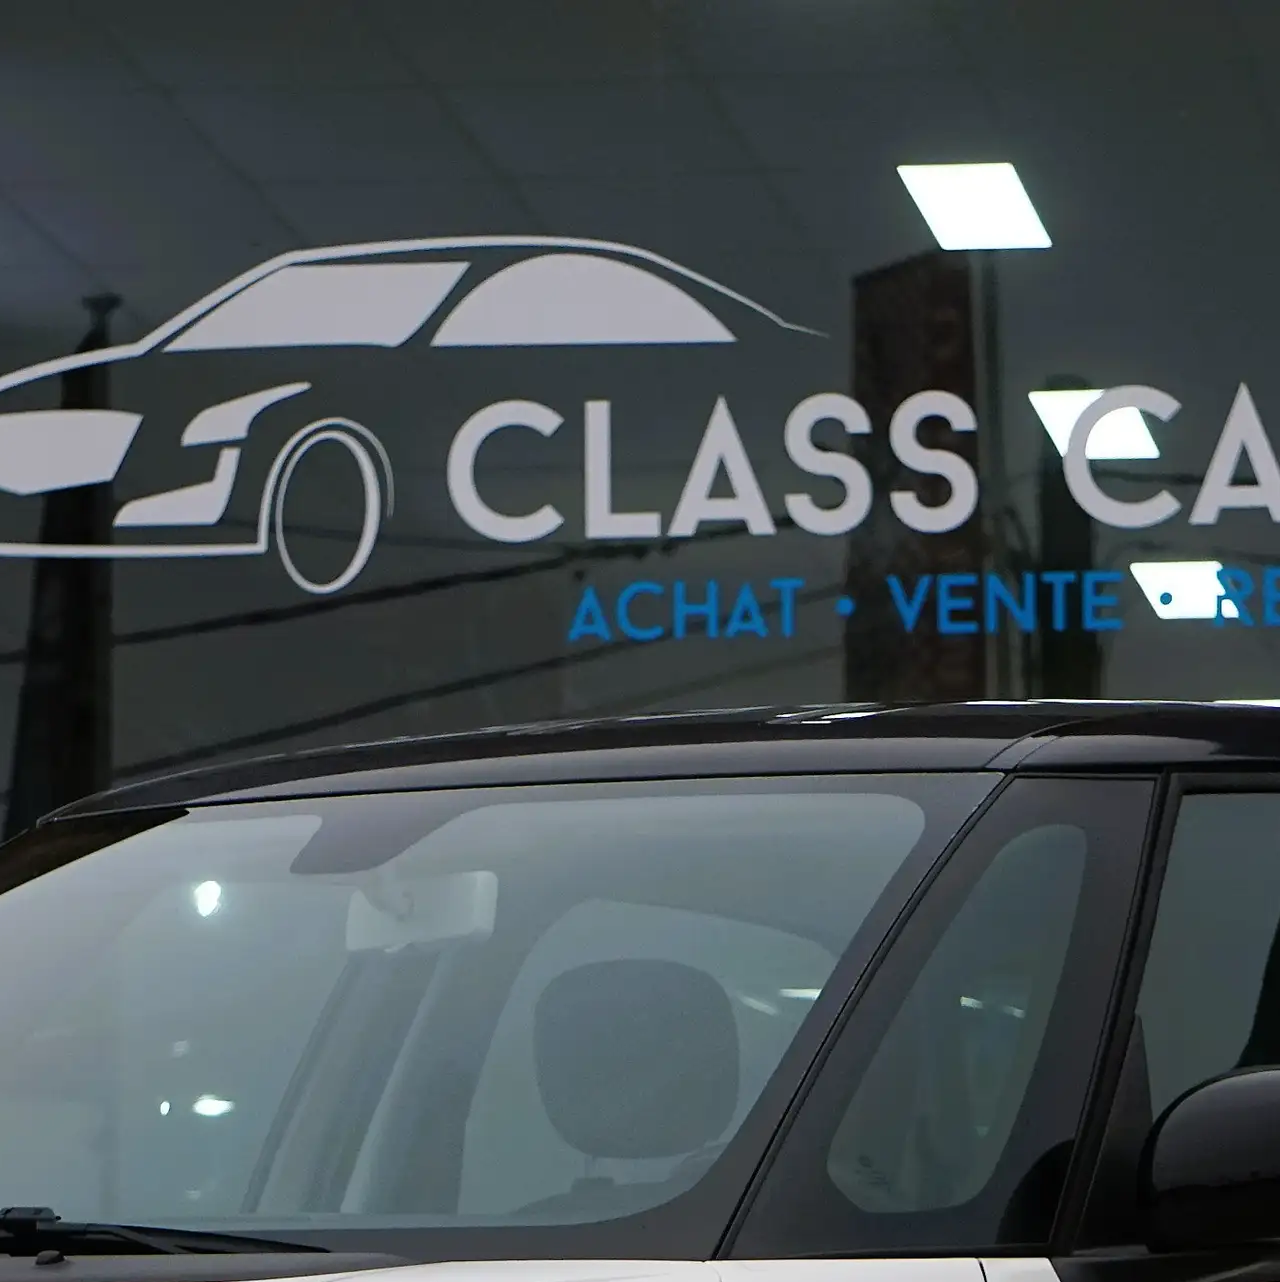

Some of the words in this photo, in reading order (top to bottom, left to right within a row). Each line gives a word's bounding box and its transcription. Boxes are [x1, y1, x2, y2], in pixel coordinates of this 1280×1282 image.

[447, 390, 978, 543] CLASS
[568, 578, 805, 643] ACHAT
[886, 570, 1124, 636] VENTE
